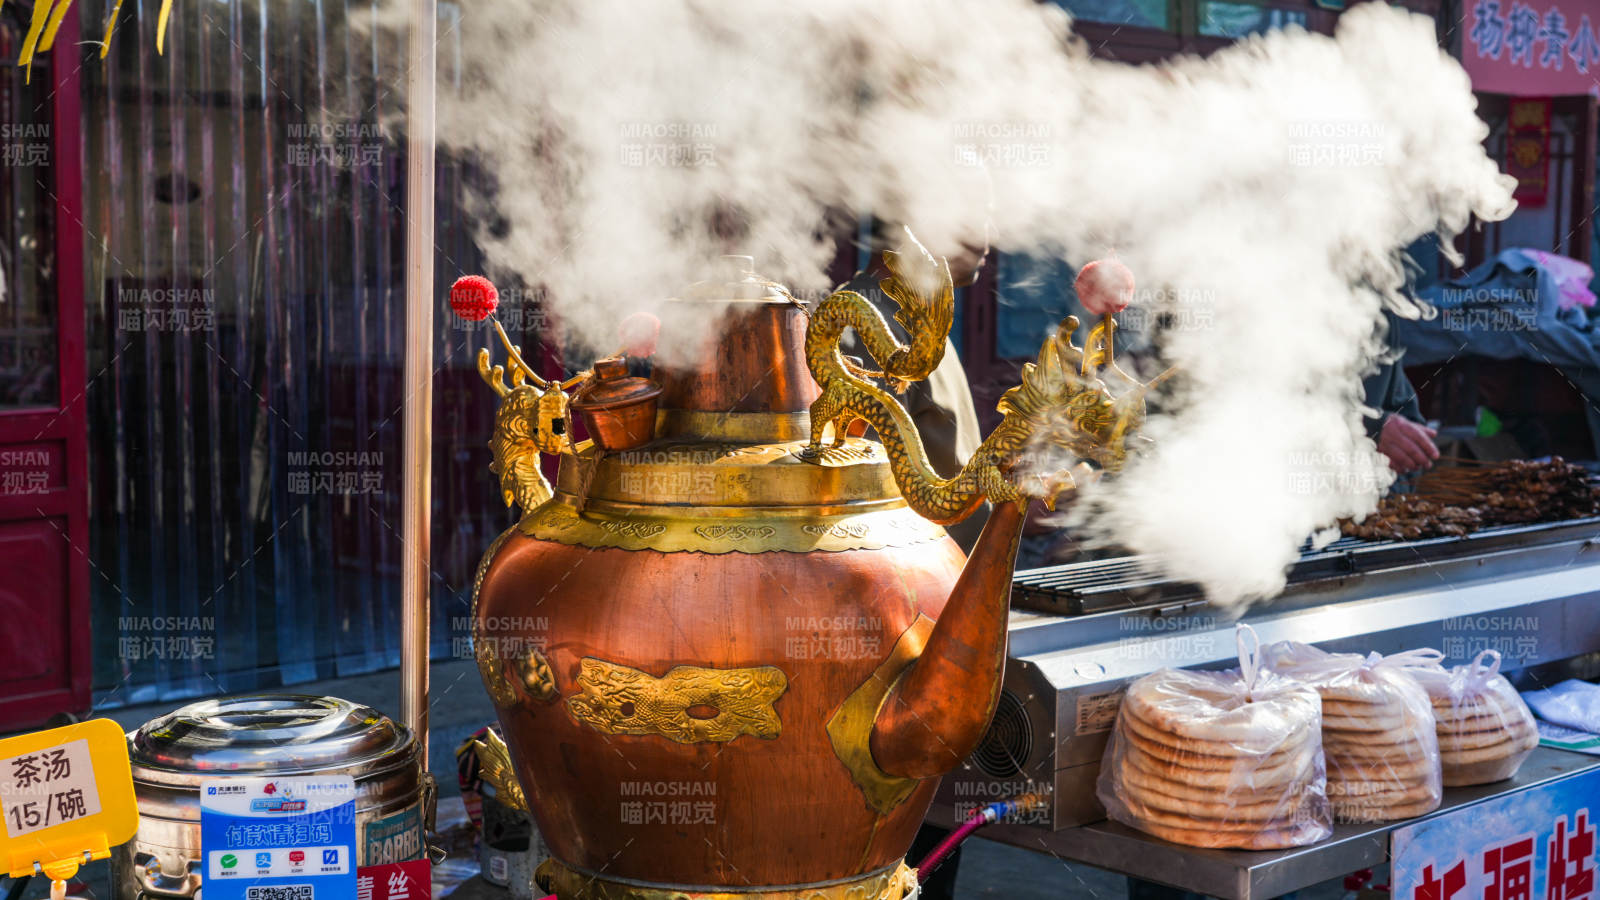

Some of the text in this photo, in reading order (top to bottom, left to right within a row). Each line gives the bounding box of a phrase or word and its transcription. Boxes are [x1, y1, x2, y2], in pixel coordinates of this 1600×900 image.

[11, 748, 71, 788] 茶汤
[9, 788, 87, 830] 15/碗
[225, 822, 333, 848] 付款请扫码
